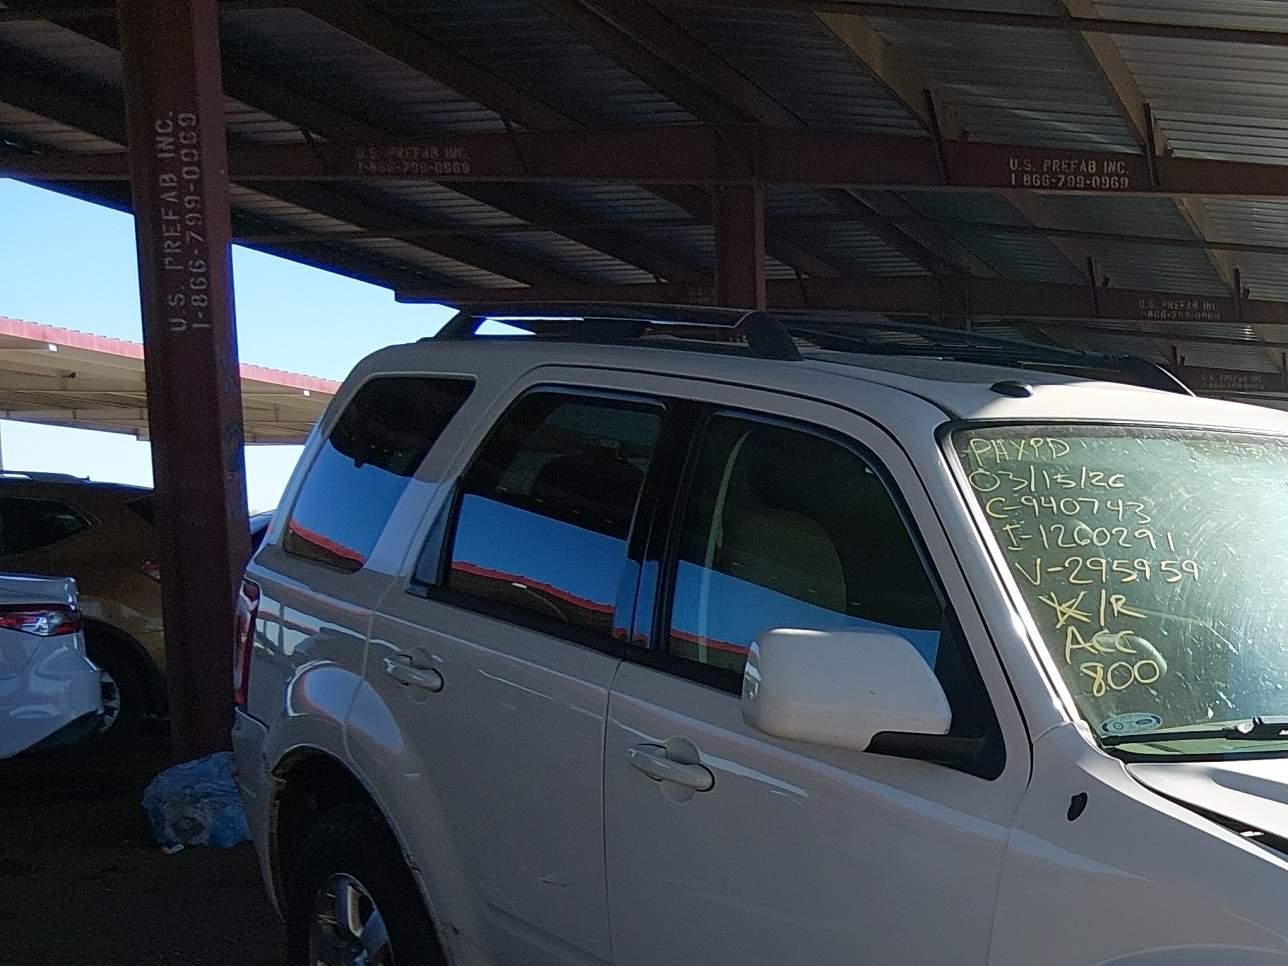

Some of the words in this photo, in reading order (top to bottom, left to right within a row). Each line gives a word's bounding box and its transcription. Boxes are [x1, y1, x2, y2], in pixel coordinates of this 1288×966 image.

[155, 111, 174, 159] INC.
[1009, 157, 1036, 172] U.S.
[1043, 159, 1097, 174] PREFAB
[1103, 160, 1129, 175] INC.
[159, 172, 185, 270] PREFAB
[168, 286, 188, 332] U.S.
[969, 465, 1126, 493] 03/15/26
[986, 495, 1153, 525] C-940743
[1015, 556, 1201, 586] V-295959
[1064, 625, 1138, 665] ACC
[1079, 659, 1161, 697] 800
